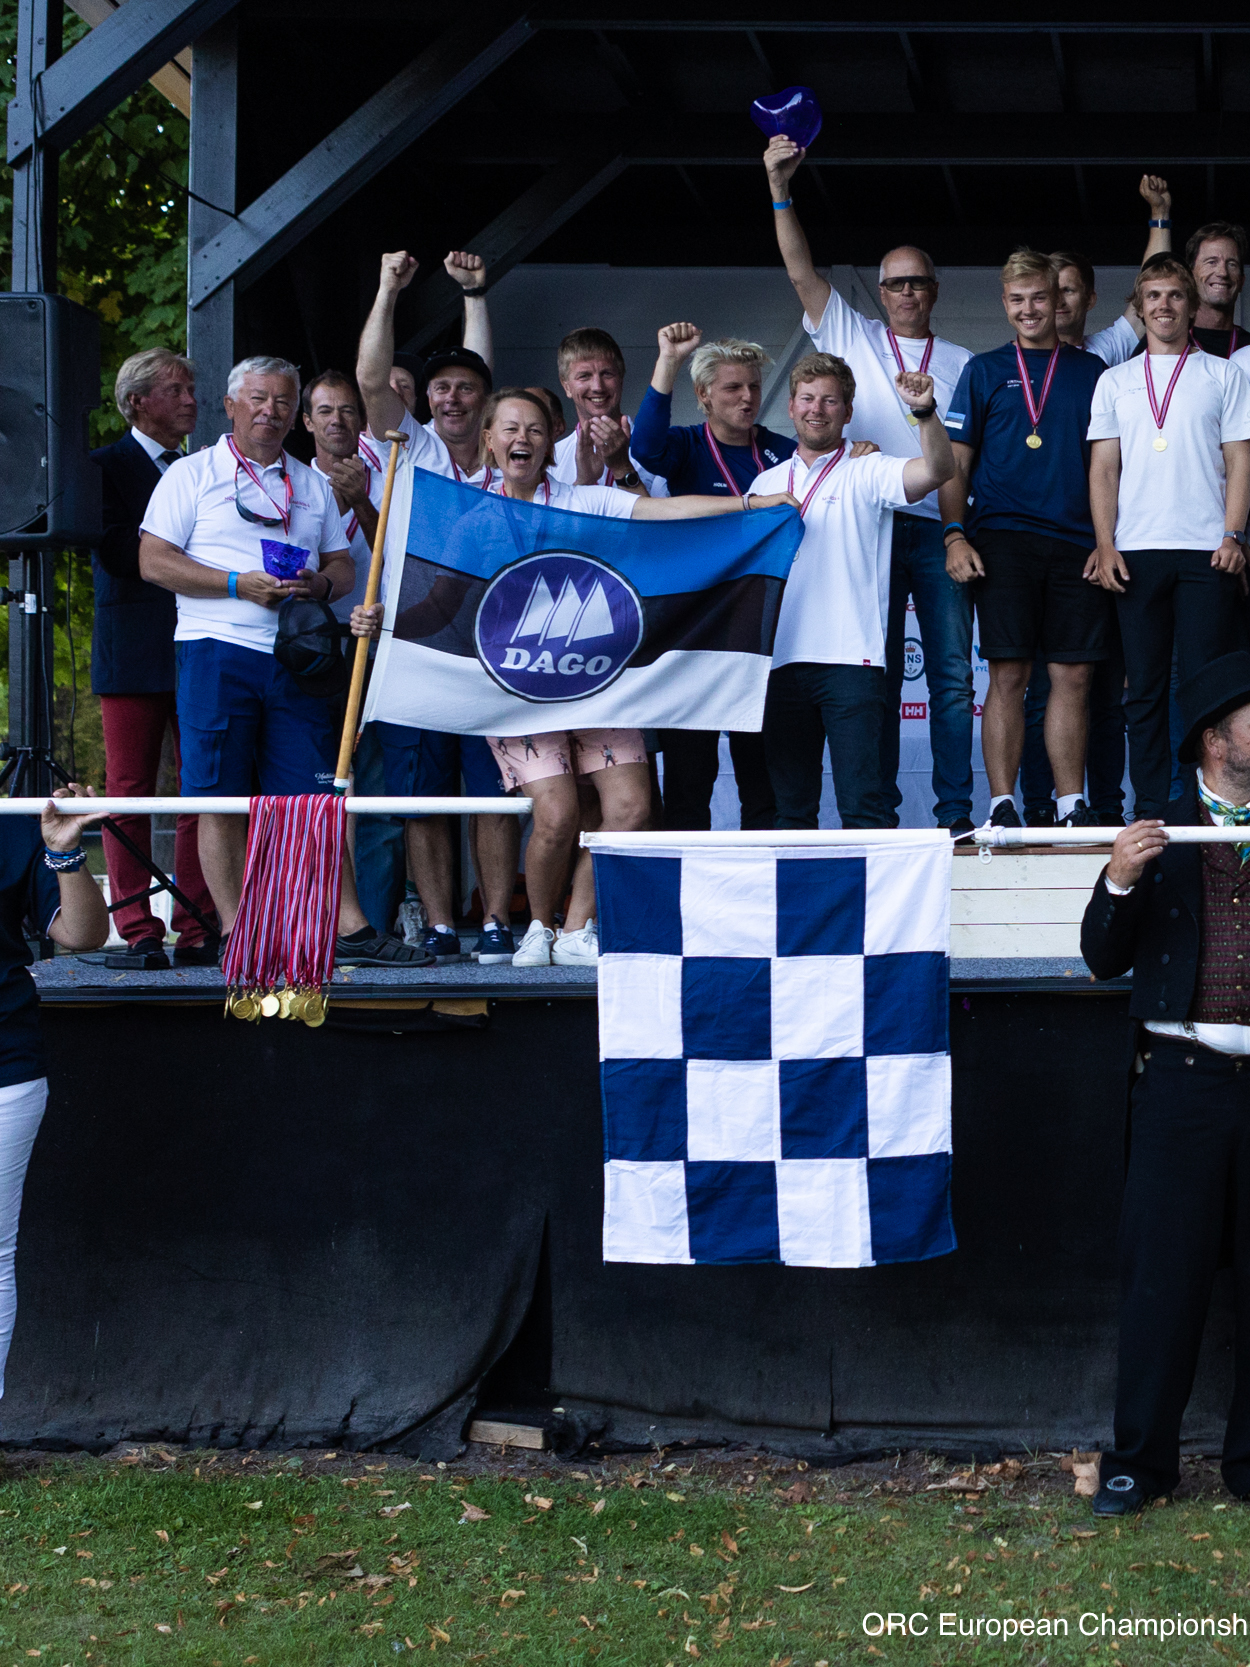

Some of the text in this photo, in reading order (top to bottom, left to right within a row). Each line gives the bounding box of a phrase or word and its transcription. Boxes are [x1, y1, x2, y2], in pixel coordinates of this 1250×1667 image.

[499, 647, 612, 677] DAGO
[903, 653, 922, 664] NS
[975, 665, 989, 673] FYL
